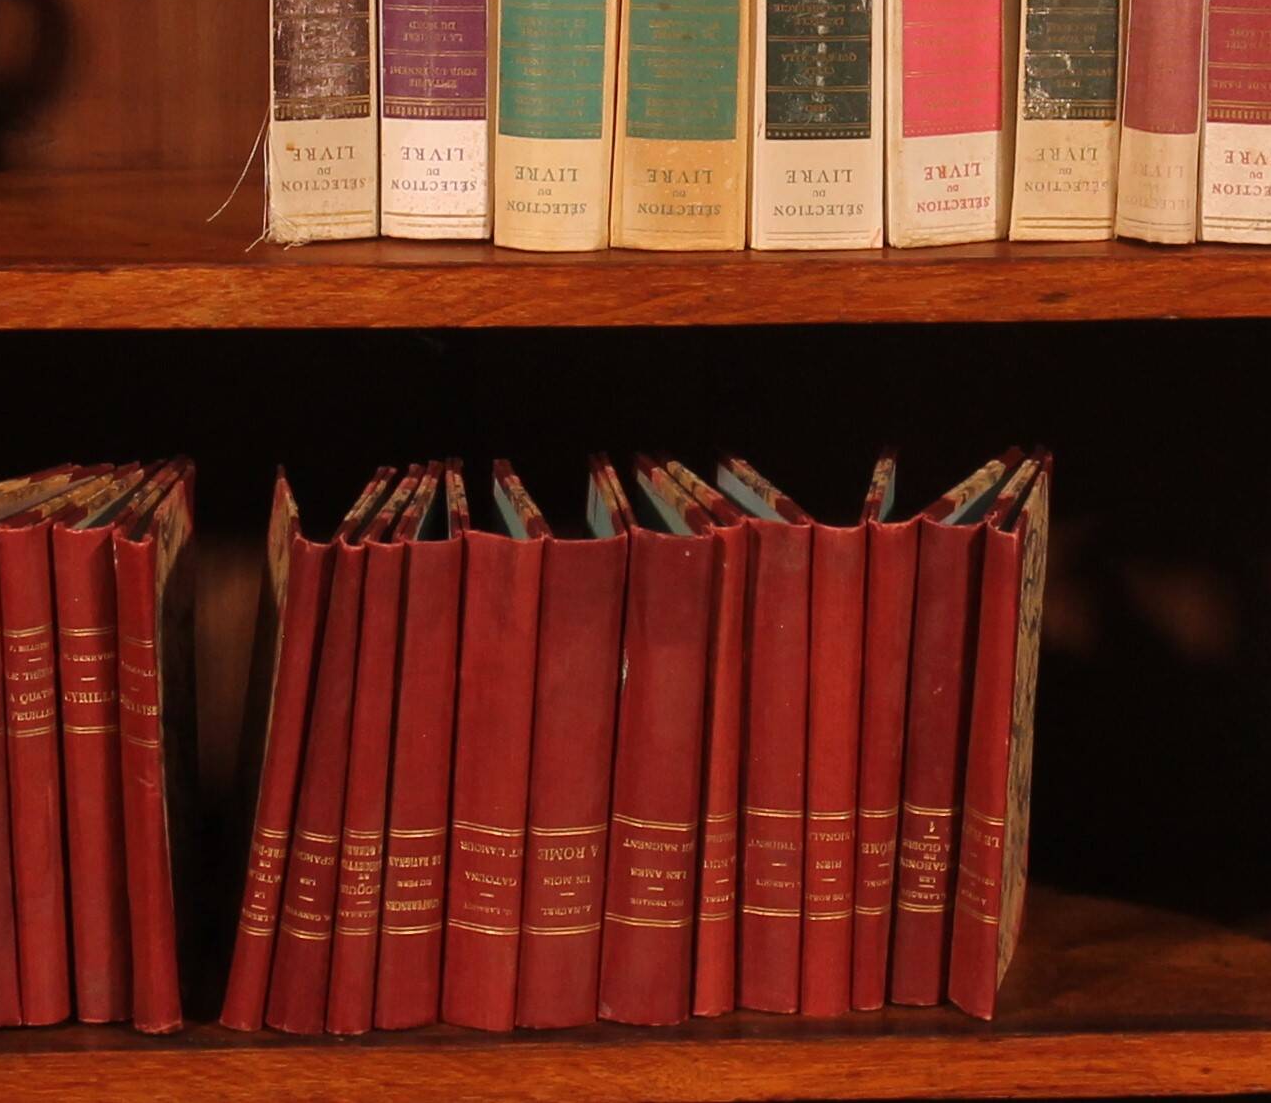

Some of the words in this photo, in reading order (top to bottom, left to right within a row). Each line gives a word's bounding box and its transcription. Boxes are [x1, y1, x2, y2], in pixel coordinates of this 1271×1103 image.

[441, 21, 456, 31] DU
[292, 145, 355, 162] LIVRE
[400, 146, 465, 162] LIVRE
[1035, 147, 1098, 162] LIVRE
[316, 167, 332, 176] DU
[426, 167, 440, 176] DU
[513, 164, 579, 183] LIVRE
[646, 168, 713, 183] LIVRE
[785, 169, 851, 184] LIVRE
[923, 162, 981, 181] LIVRE
[1059, 167, 1073, 176] DU
[1249, 170, 1262, 180] DU
[280, 178, 366, 193] SÉLECTION
[390, 179, 478, 194] SÉLECTION
[537, 188, 553, 197] DU
[946, 184, 960, 192] DU
[1024, 180, 1109, 194] SÉLECTION
[671, 190, 686, 198] DU
[812, 190, 826, 198] DU
[505, 199, 588, 216] SÉLECTION
[637, 202, 722, 217] SÉLECTION
[772, 203, 864, 218] SÉLECTION
[917, 196, 990, 213] SÉLECTION
[458, 838, 506, 857] L'AMOUR
[623, 837, 680, 853] SAIGNENT
[537, 845, 586, 861] ROME
[816, 860, 843, 870] RIEN
[299, 876, 316, 887] LES
[464, 869, 517, 888] GATOUNA
[543, 874, 573, 886] MOIS
[578, 874, 591, 884] UN
[667, 870, 687, 880] LES
[918, 875, 937, 884] LES
